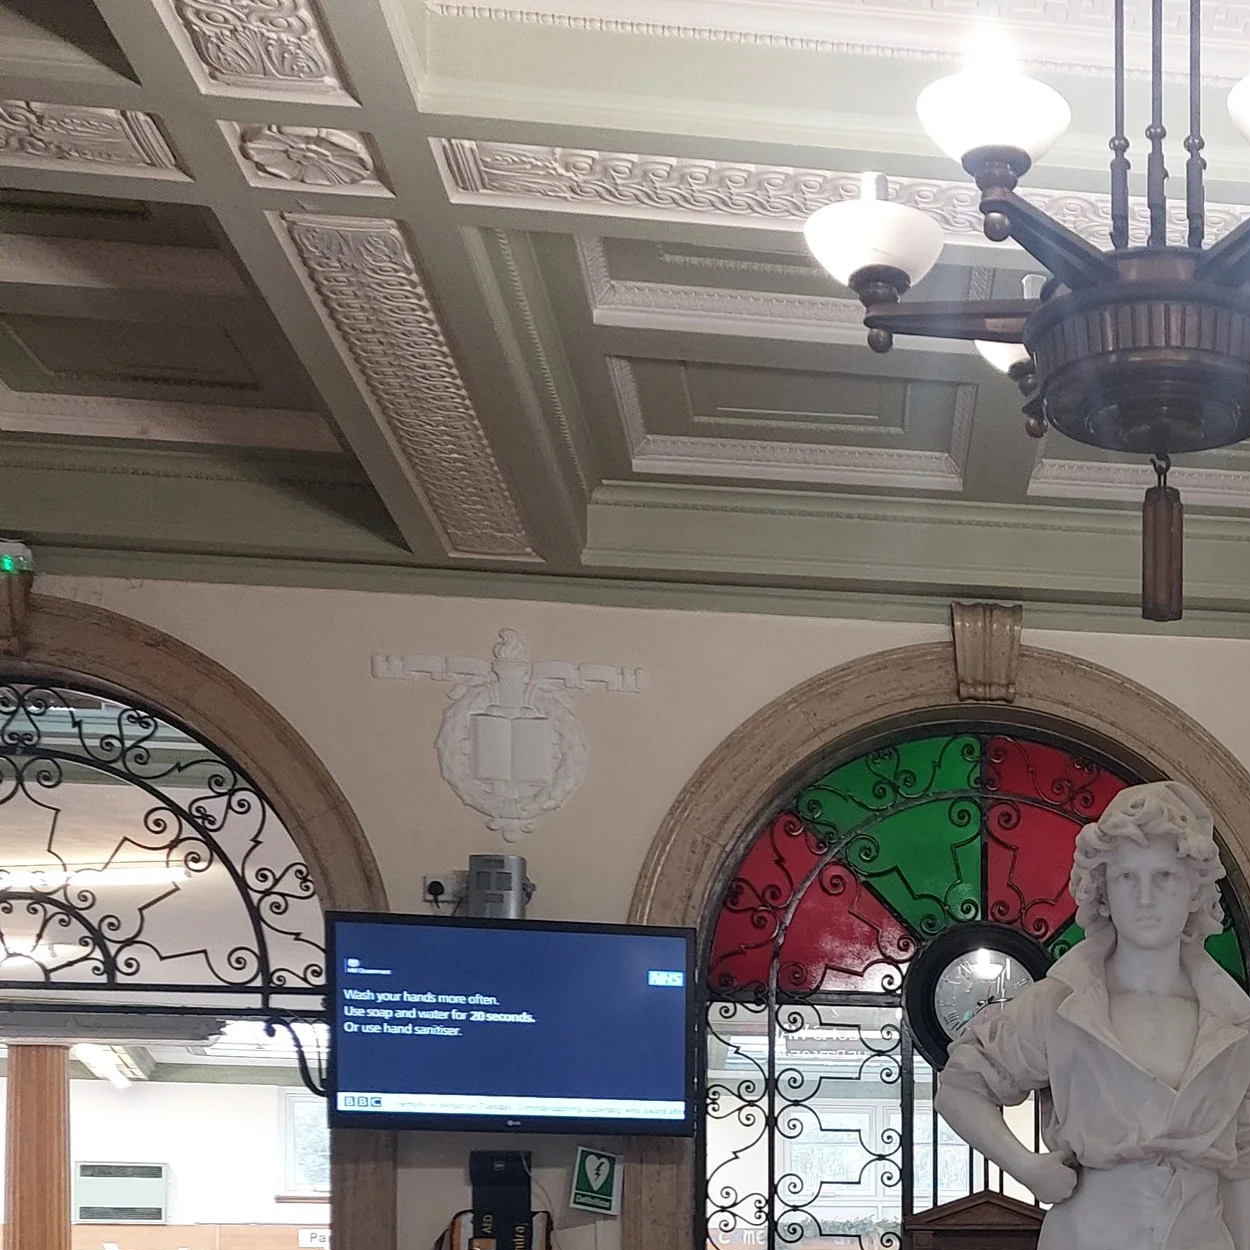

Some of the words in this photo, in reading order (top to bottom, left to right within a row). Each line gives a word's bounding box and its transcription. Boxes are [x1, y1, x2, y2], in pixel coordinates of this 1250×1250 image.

[343, 989, 375, 1000] Wash
[375, 992, 402, 1003] your
[403, 991, 437, 1003] hands
[438, 995, 467, 1004] more
[468, 994, 500, 1005] often.
[344, 1006, 366, 1017] Use
[366, 1008, 393, 1020] soap
[394, 1008, 417, 1018] and
[417, 1010, 450, 1020] water
[450, 1008, 468, 1020] for
[469, 1011, 486, 1021] 20
[486, 1011, 536, 1023] seconds.
[343, 1022, 360, 1032] Or
[361, 1024, 382, 1033] use
[383, 1023, 413, 1034] hand
[414, 1024, 464, 1036] sanitiser.
[344, 1096, 382, 1108] BBC
[309, 1232, 327, 1243] Pa
